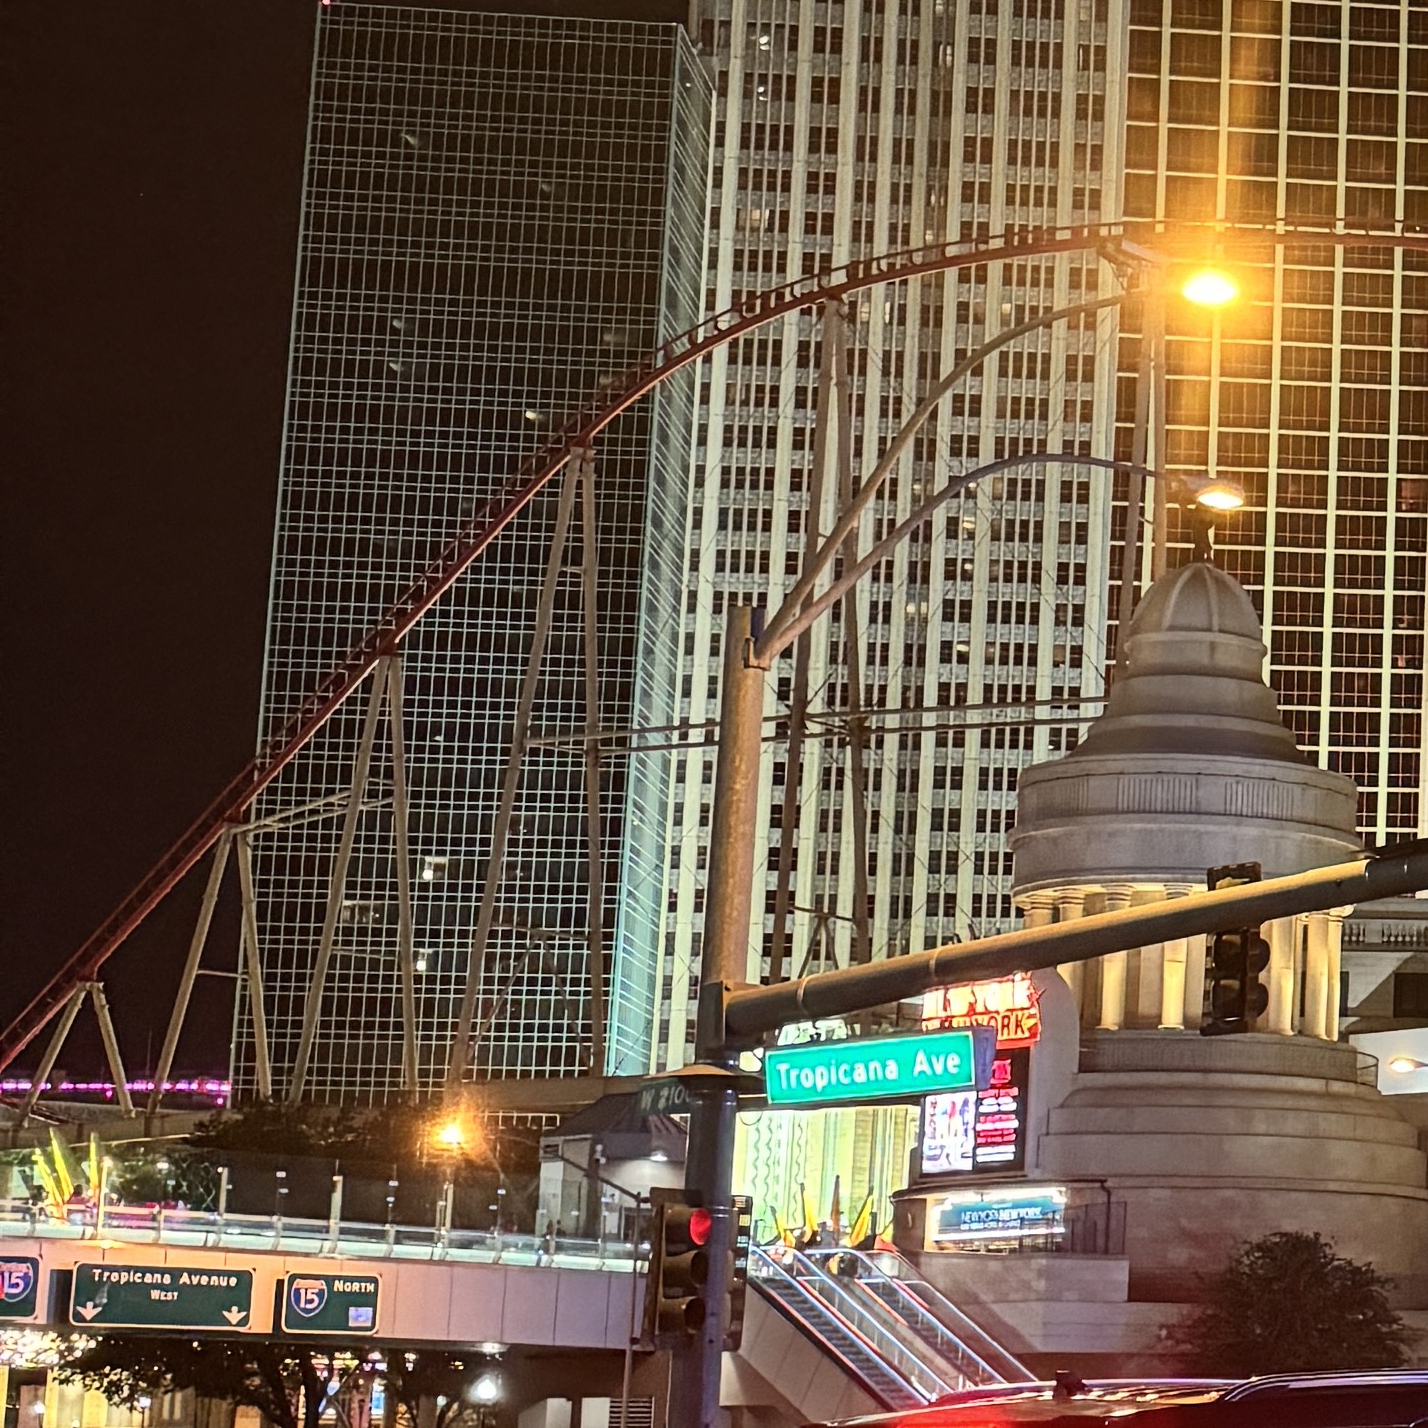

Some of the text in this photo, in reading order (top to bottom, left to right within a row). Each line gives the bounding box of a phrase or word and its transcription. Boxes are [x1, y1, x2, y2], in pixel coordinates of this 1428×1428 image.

[775, 1049, 961, 1093] Tropicana Ave
[4, 1271, 24, 1293] 15
[93, 1269, 237, 1287] Tropicana Avenue
[333, 1279, 375, 1292] NORTH
[150, 1289, 178, 1300] WEST
[299, 1288, 319, 1309] 15
